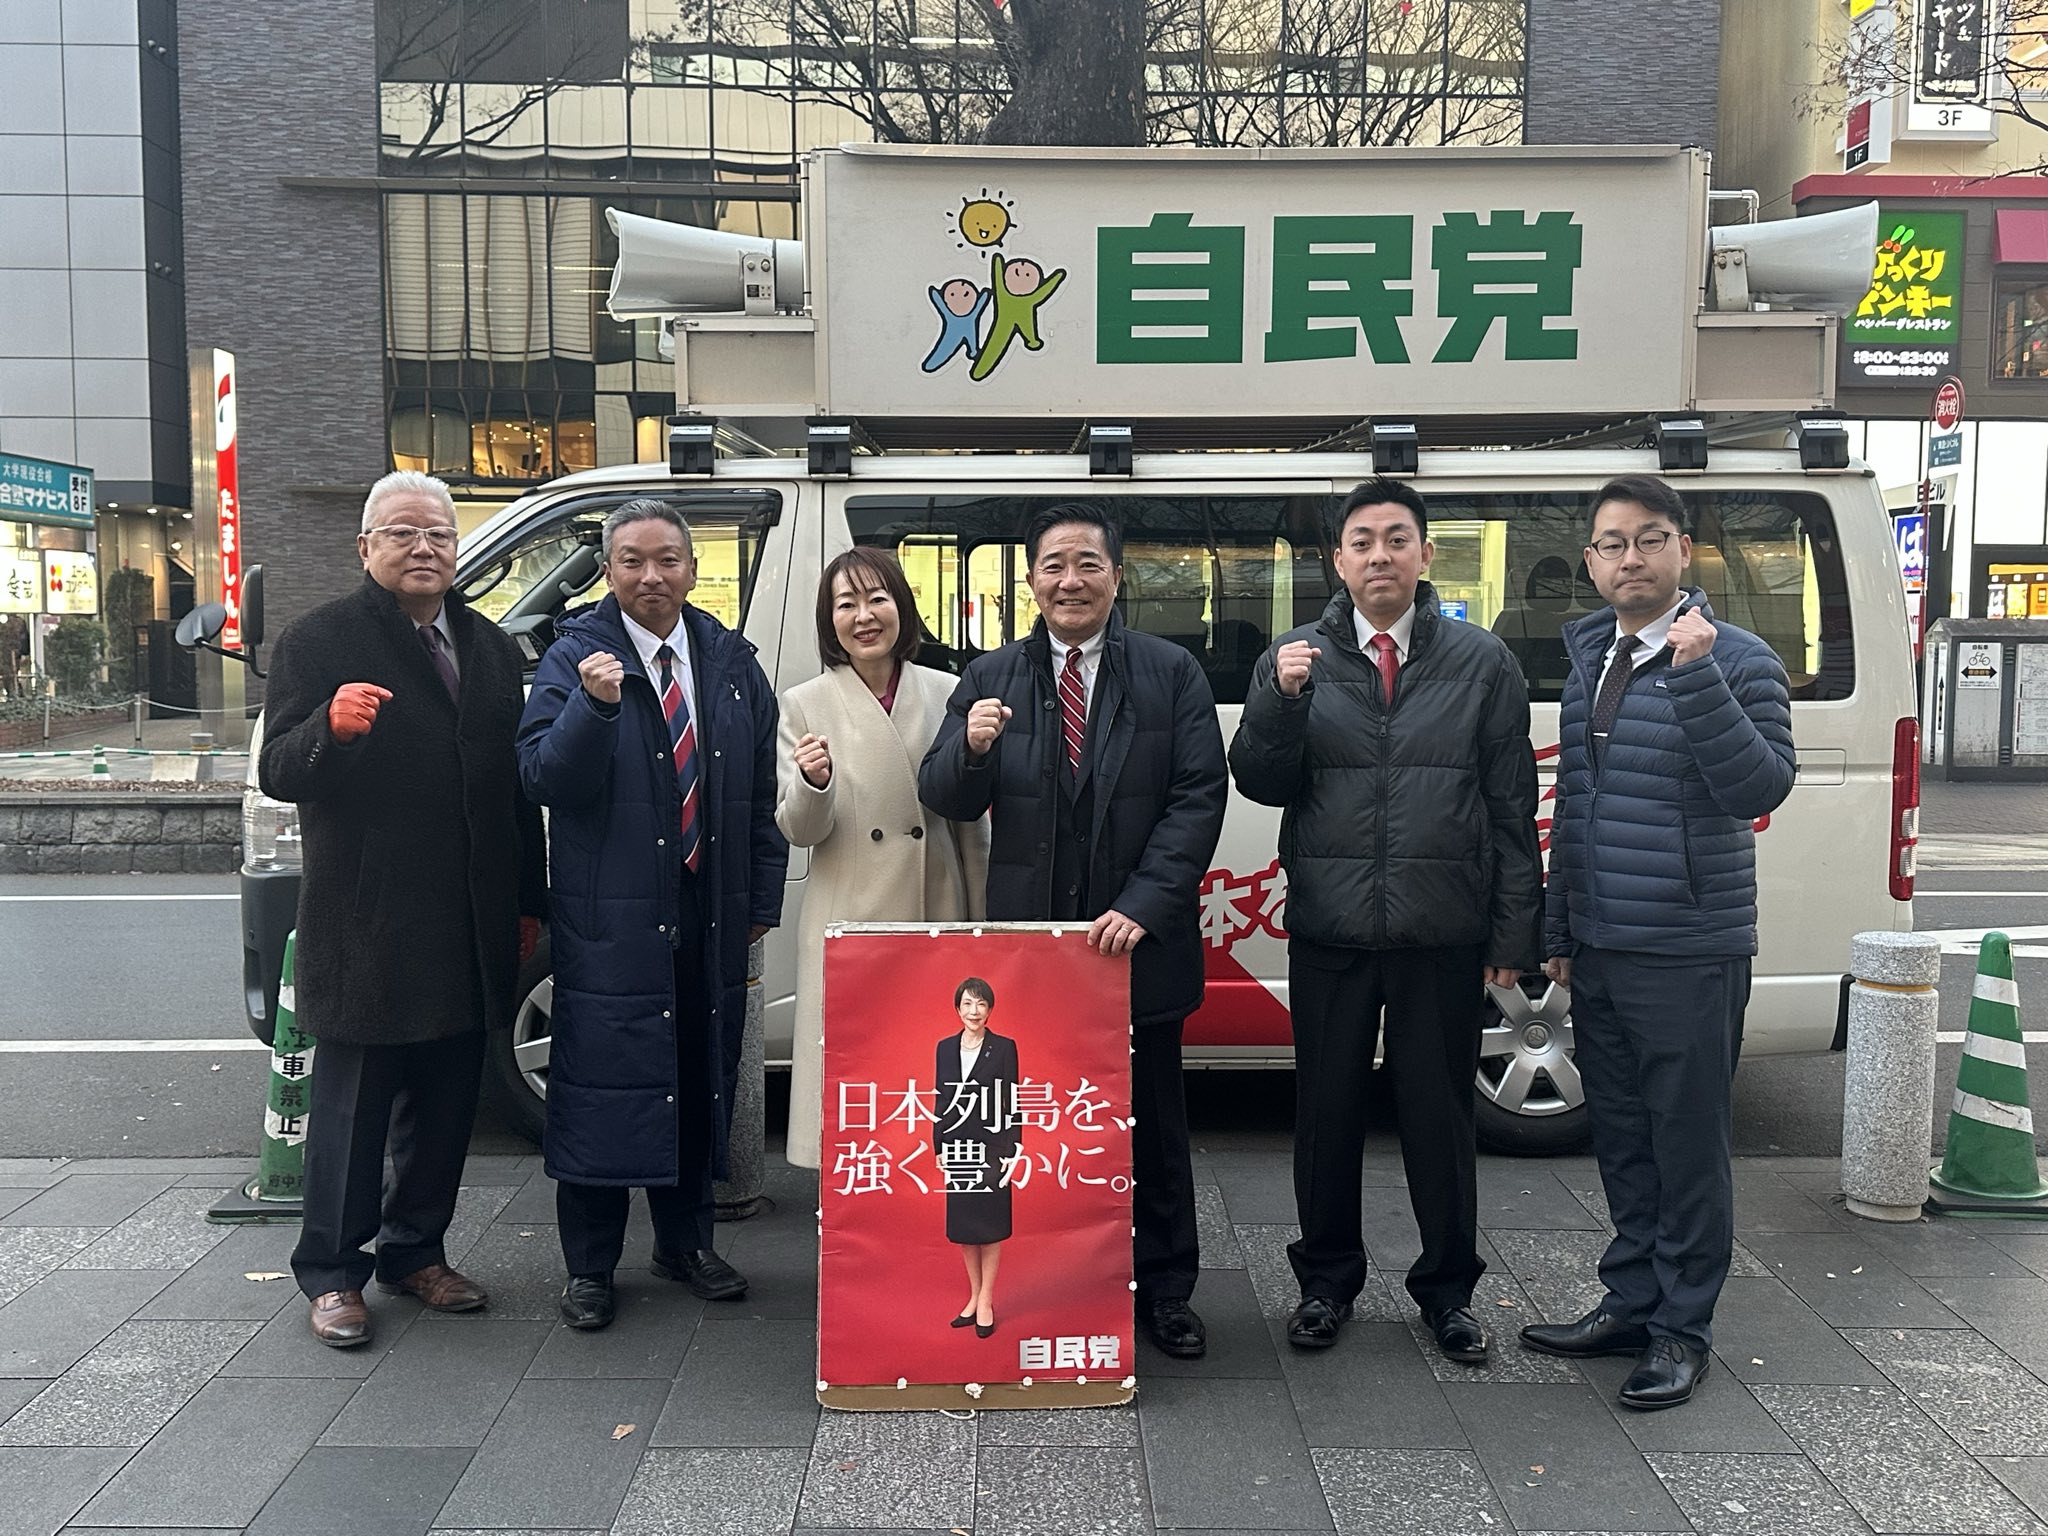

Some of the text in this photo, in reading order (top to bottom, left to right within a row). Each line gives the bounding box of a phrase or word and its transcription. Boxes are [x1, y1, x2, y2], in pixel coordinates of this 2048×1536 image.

[1938, 110, 1963, 126] 3F
[1854, 149, 1864, 162] 1F
[1096, 210, 1583, 364] 自民党
[1854, 318, 1952, 331] ハンバーグレストラン
[1937, 398, 1958, 417] 消火栓
[3, 464, 53, 483] 大学現役合格
[71, 477, 88, 494] 受付
[72, 495, 87, 512] 8F
[220, 488, 238, 619] たましん
[837, 1077, 1130, 1134] 日本列島を、
[833, 1138, 1131, 1196] 強く豊かに。
[1019, 1336, 1121, 1370] 自民党
